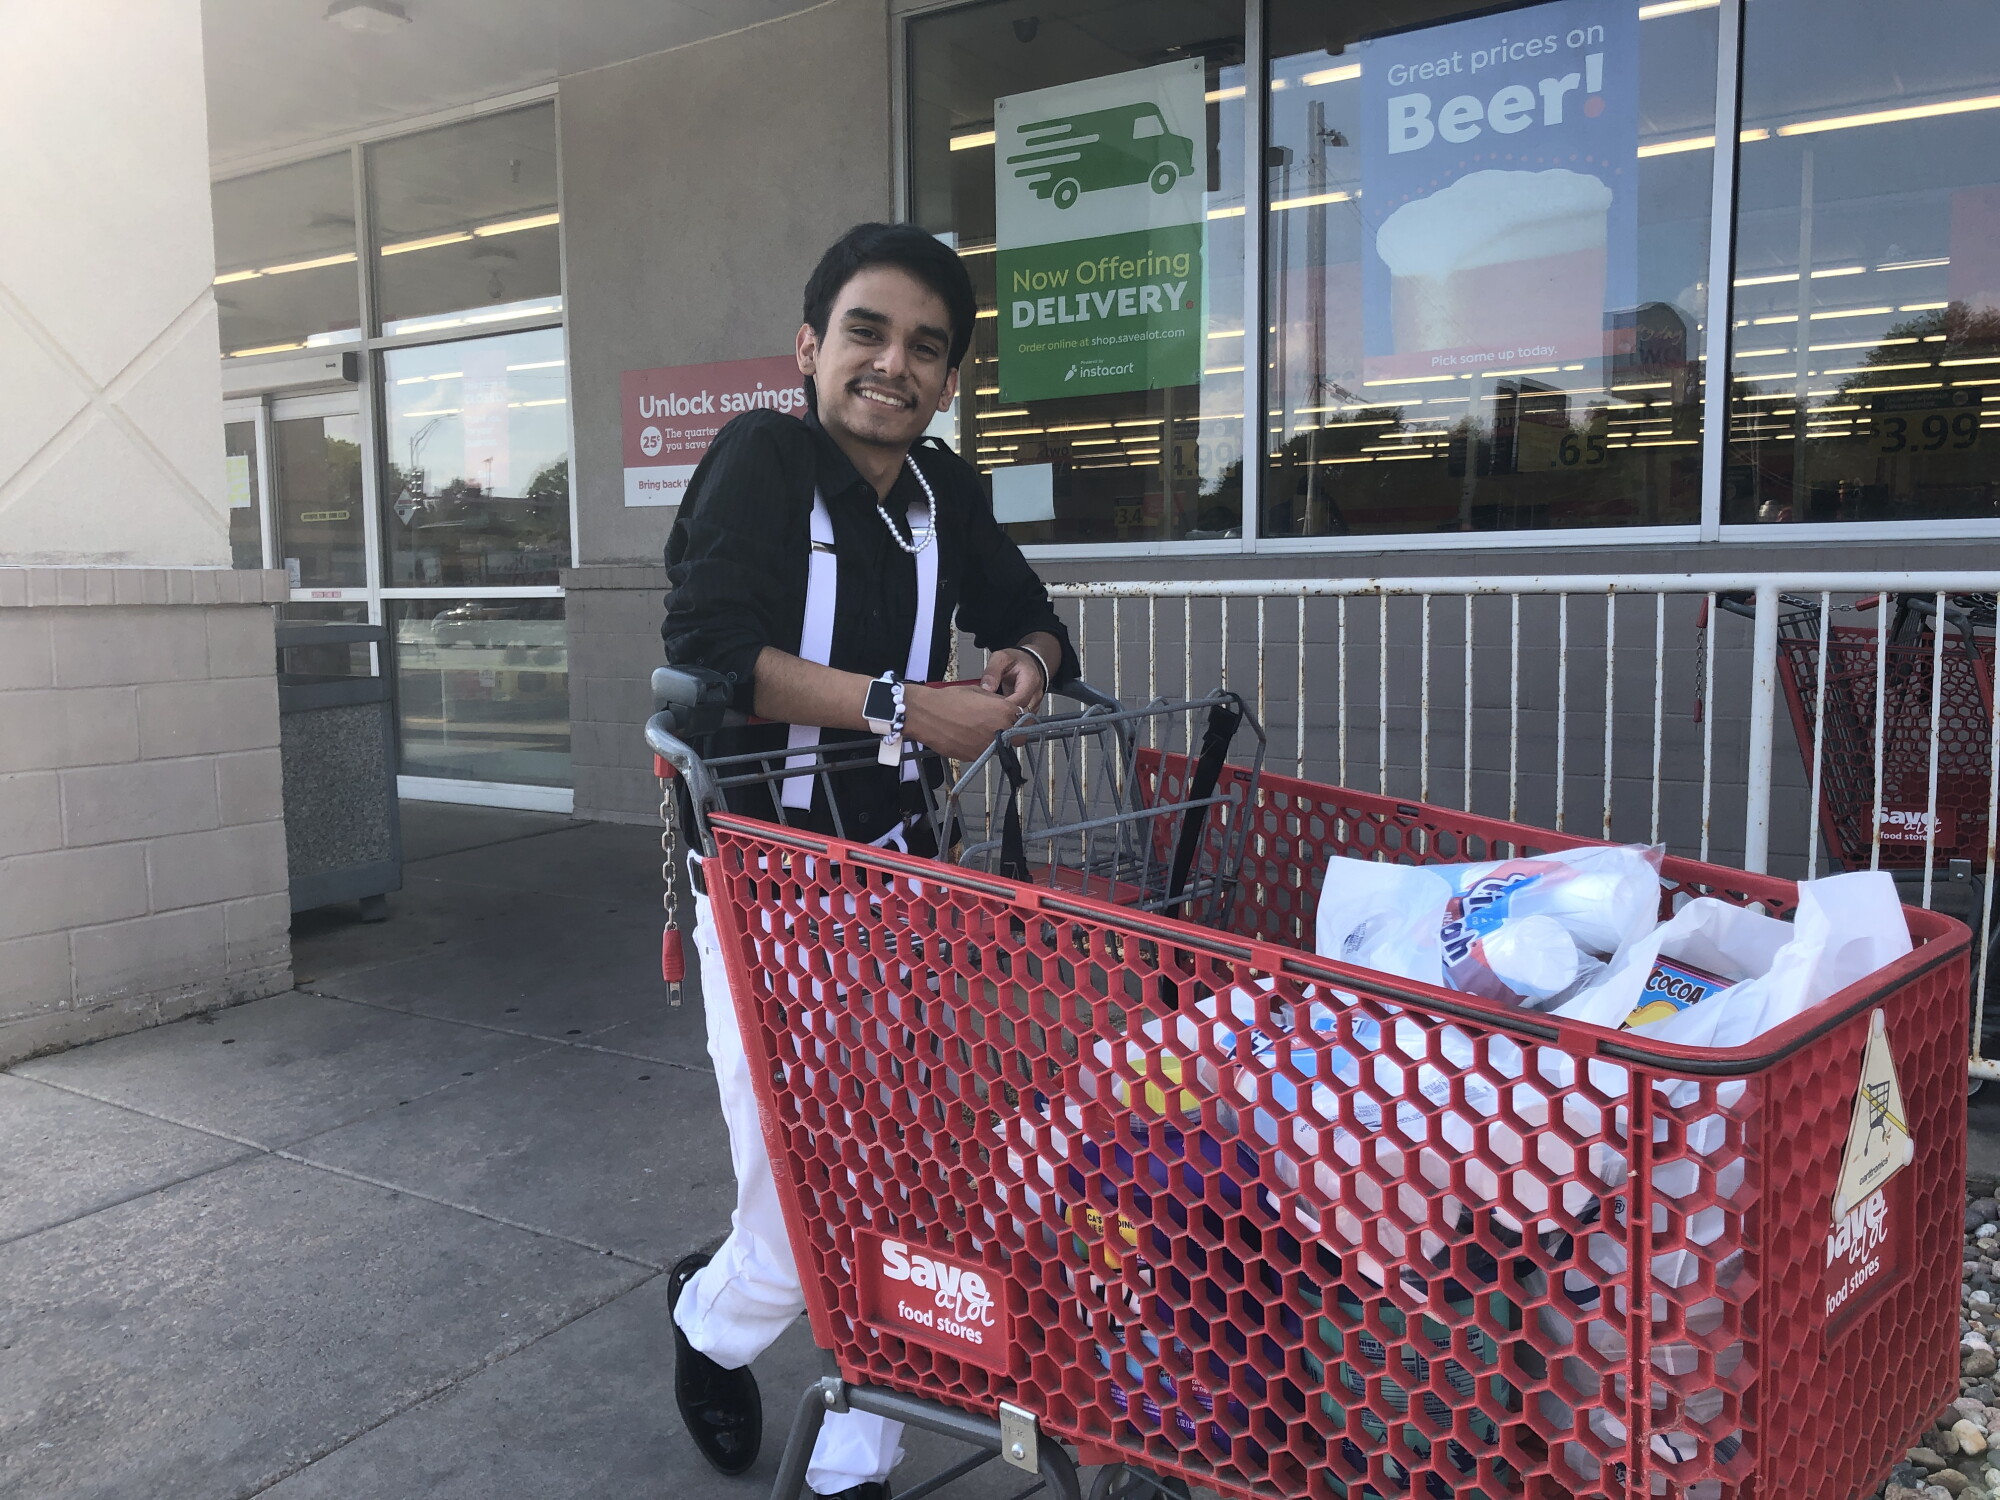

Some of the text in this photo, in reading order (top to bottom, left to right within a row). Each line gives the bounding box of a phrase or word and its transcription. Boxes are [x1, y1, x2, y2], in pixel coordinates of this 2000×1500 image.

[1388, 25, 1604, 86] Great prices on
[1388, 53, 1605, 155] Beer!
[1013, 250, 1190, 293] Now Offering
[1012, 281, 1194, 329] DELIVERY.
[1018, 328, 1185, 353] Order online at shop.savealot.com
[1431, 345, 1557, 367] Pick some up today.
[1080, 362, 1134, 378] instacart
[639, 390, 715, 418] Unlock
[665, 427, 719, 440] The quarter
[666, 443, 682, 453] you
[685, 441, 706, 450] save
[639, 480, 661, 491] Bring
[662, 480, 682, 488] back
[1645, 969, 1707, 1006] COCOA
[881, 1239, 986, 1302] Save
[1826, 1255, 1880, 1317] food stores
[898, 1300, 982, 1345] food stores
